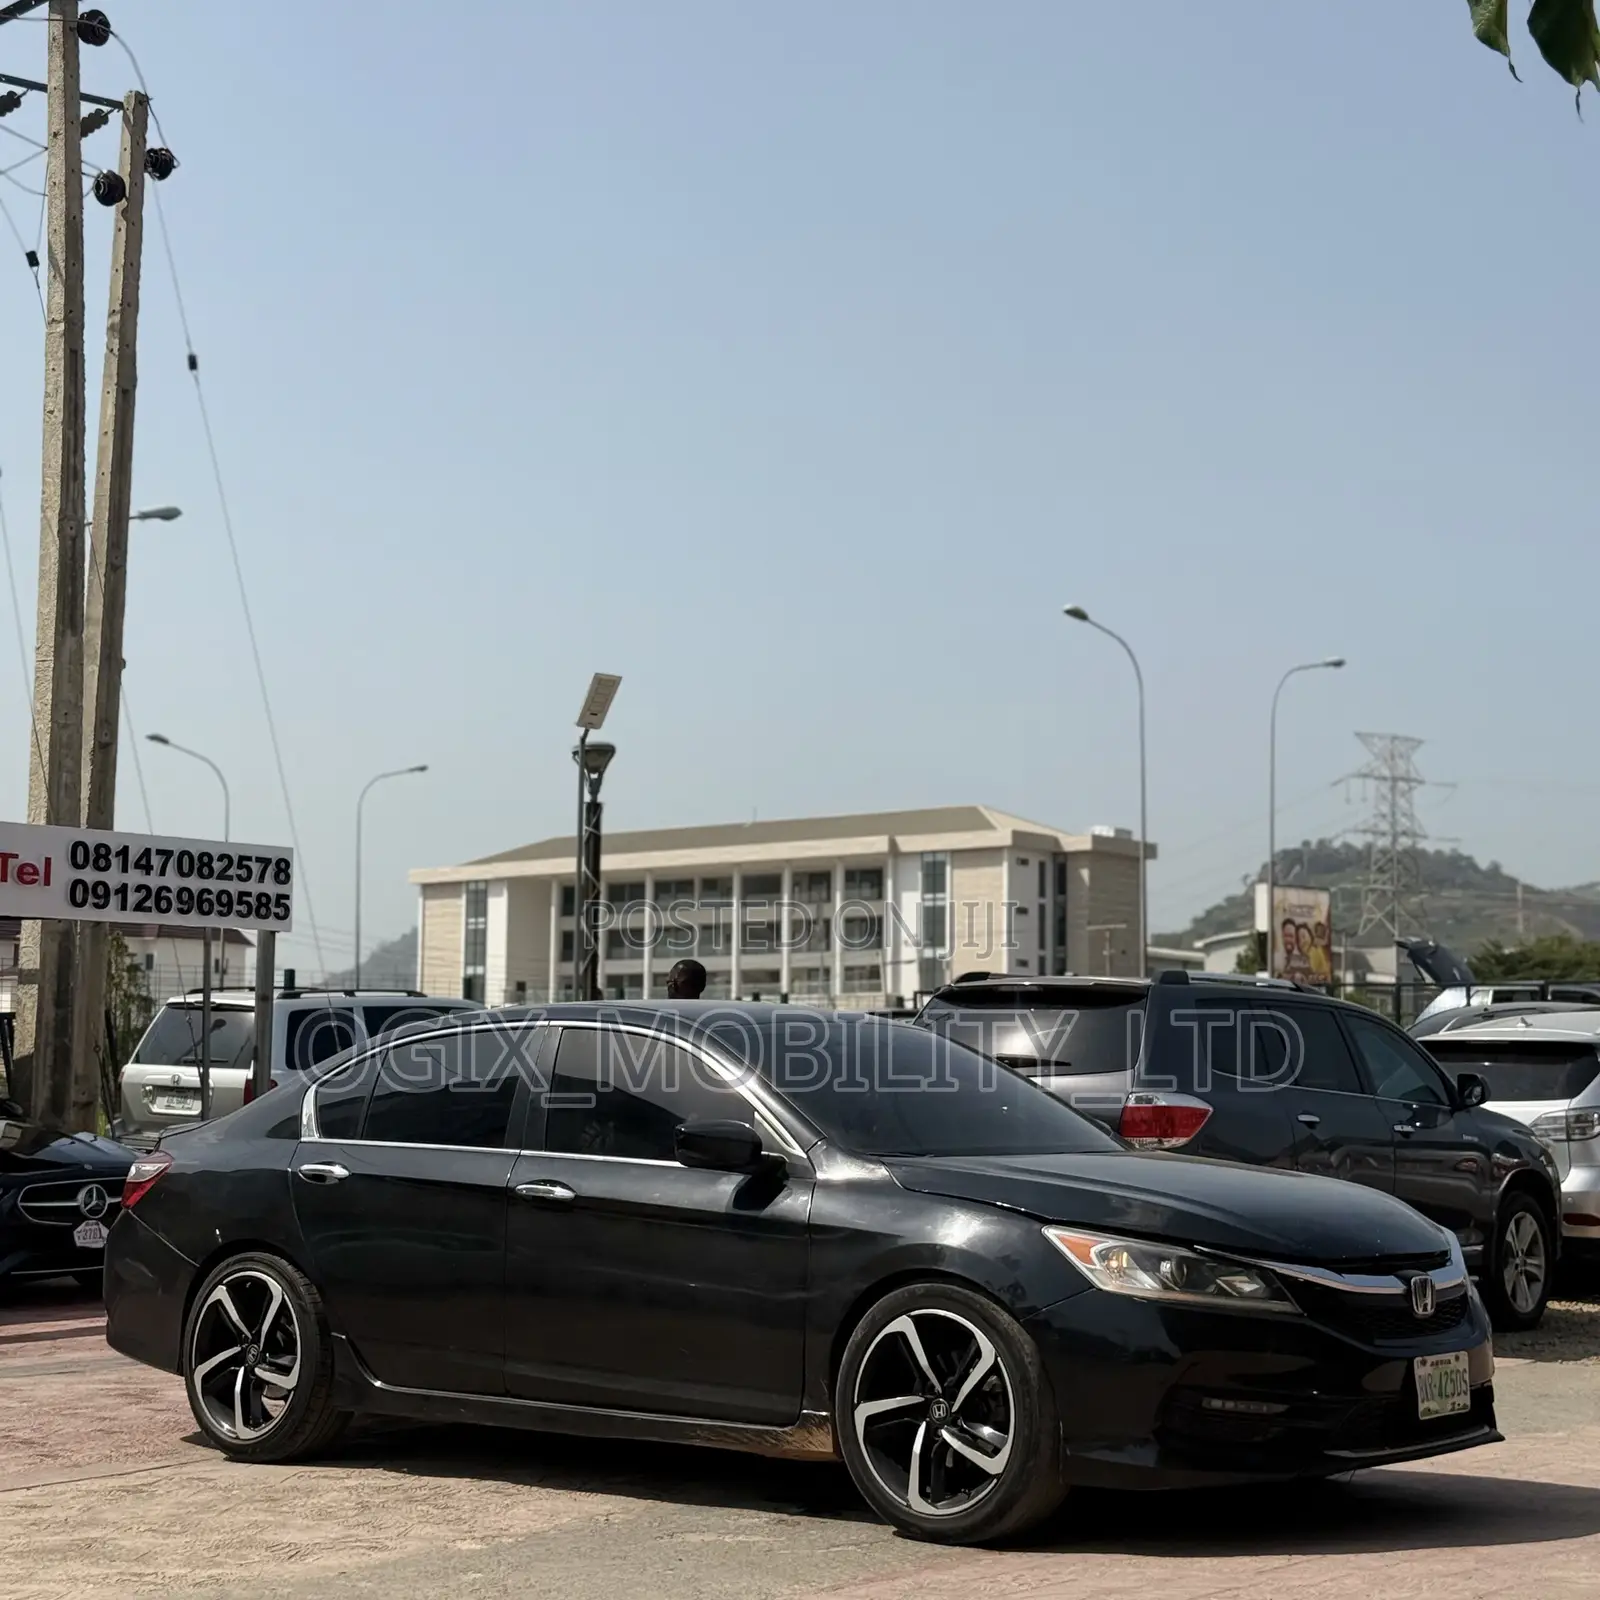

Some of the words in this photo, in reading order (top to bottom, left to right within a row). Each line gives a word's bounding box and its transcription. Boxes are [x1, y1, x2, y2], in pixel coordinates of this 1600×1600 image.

[0, 852, 52, 886] Tel
[69, 840, 291, 885] 08147082578
[69, 878, 291, 921] 09126969585
